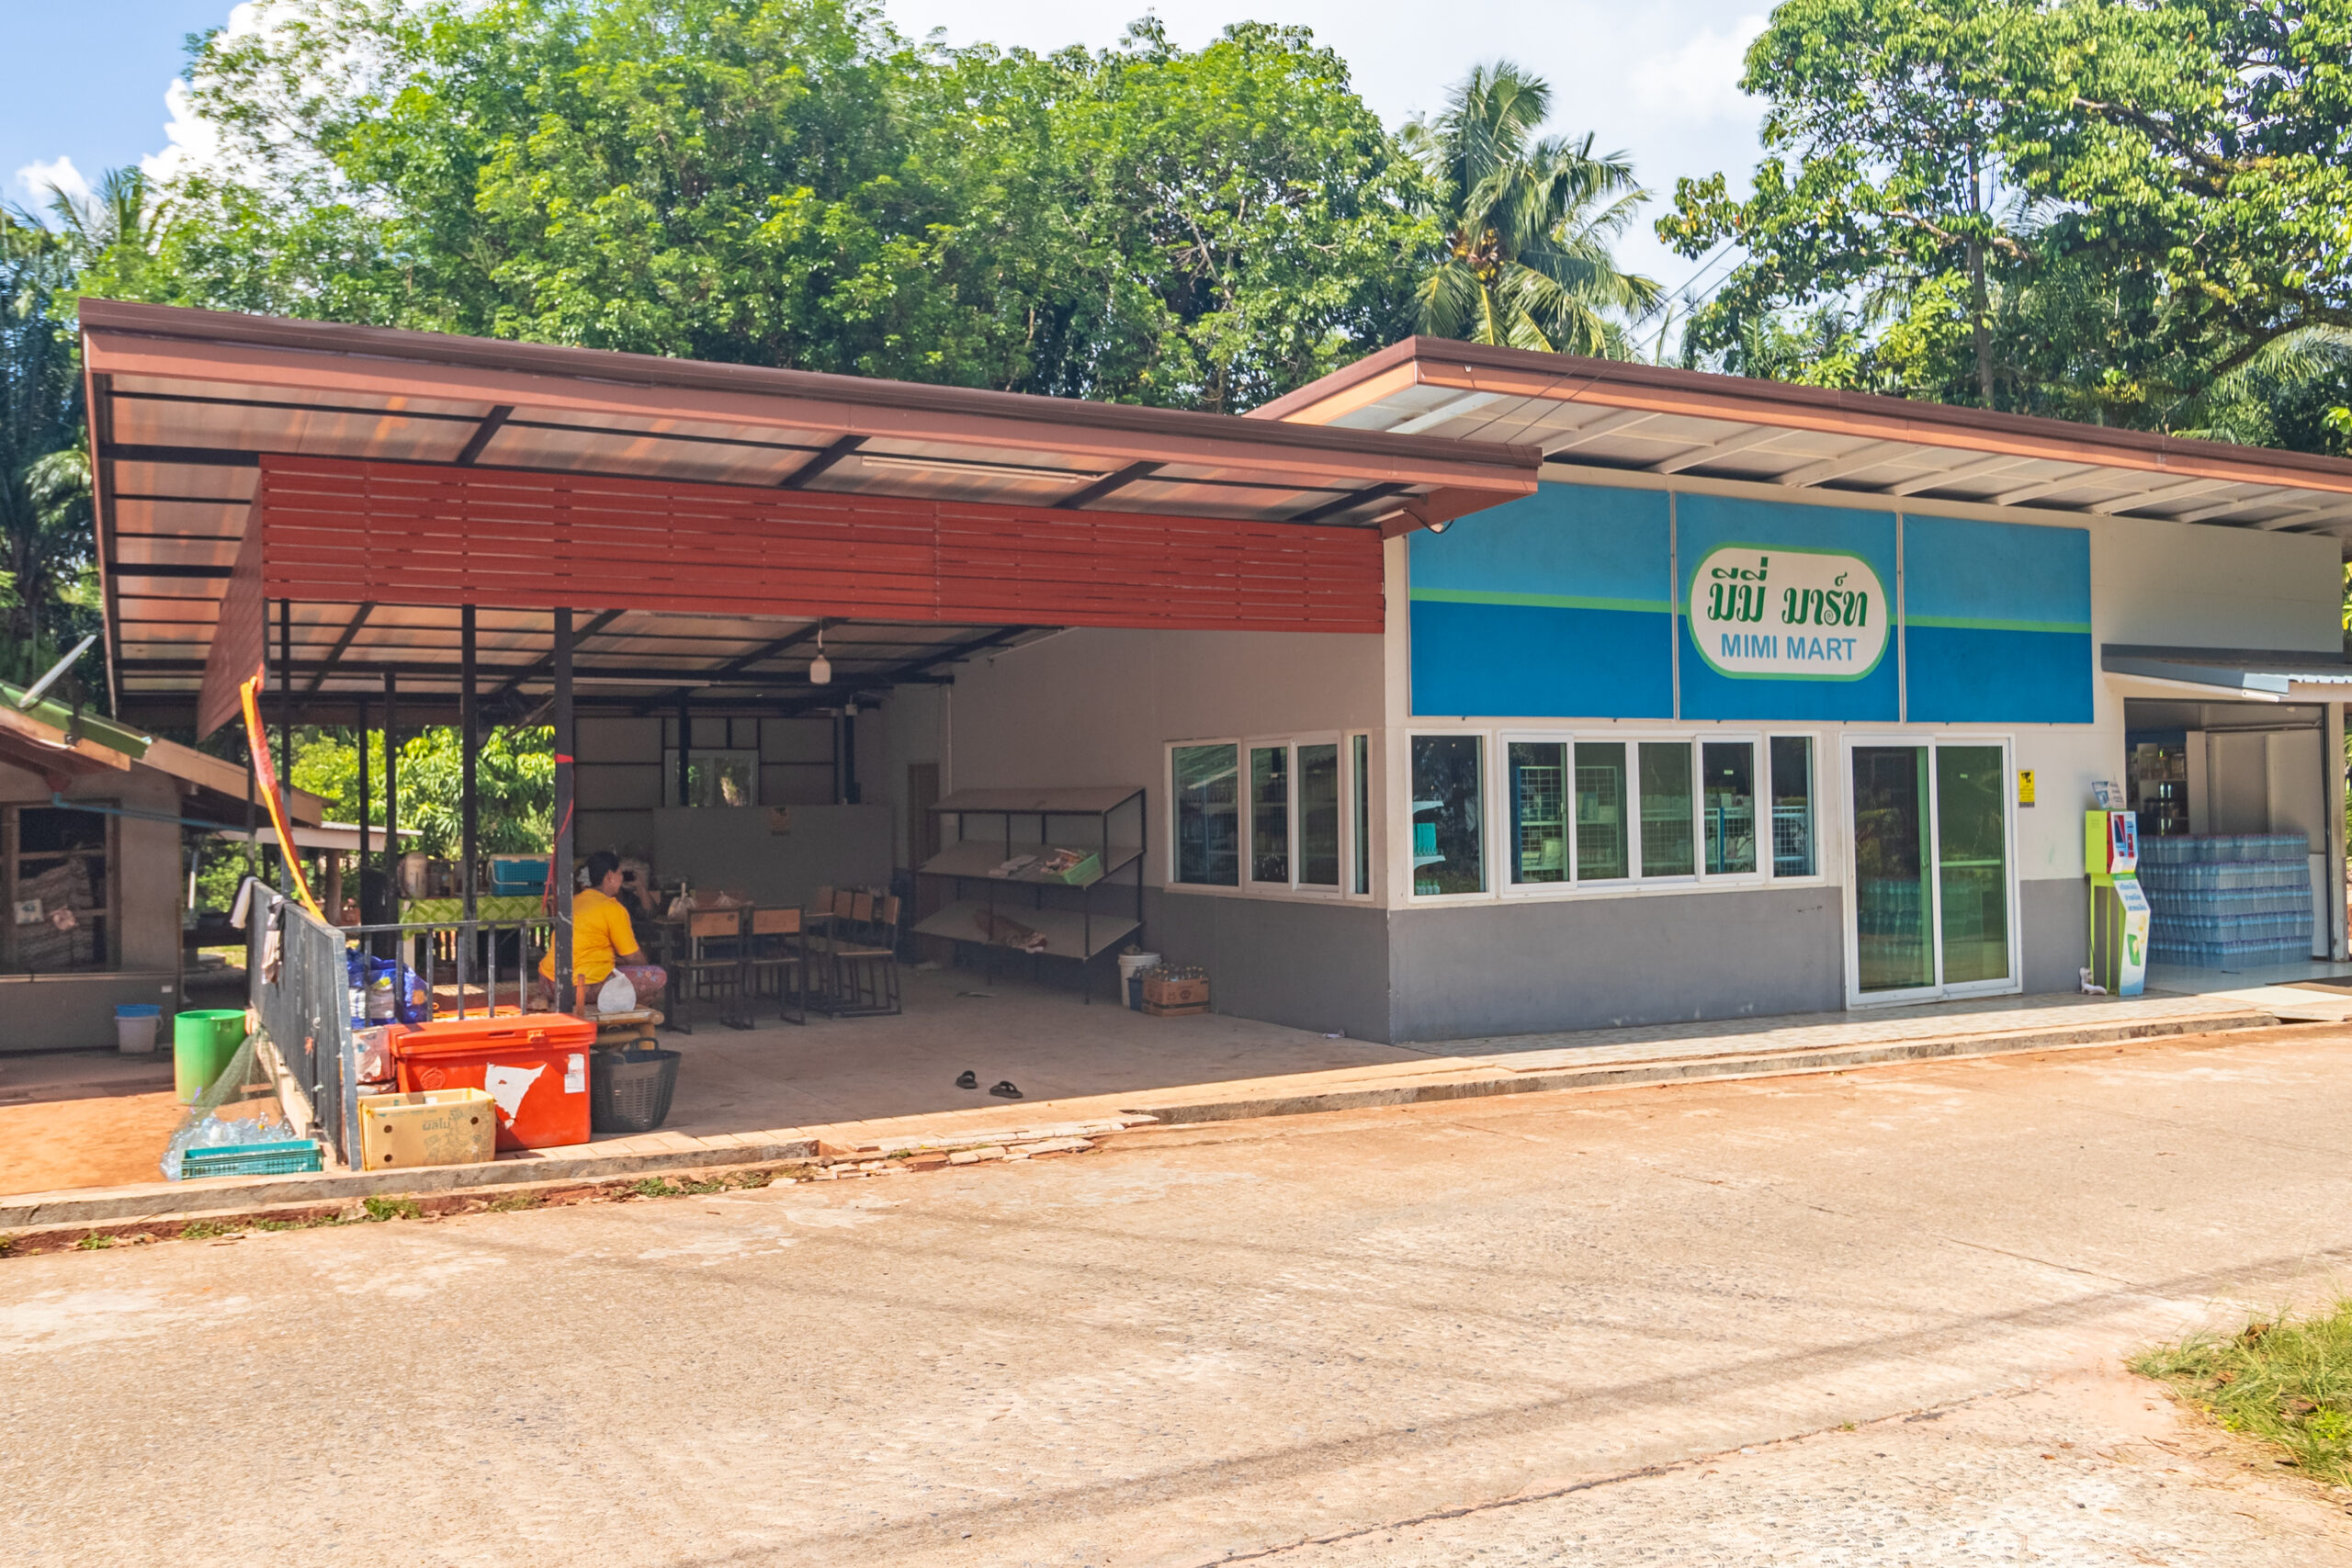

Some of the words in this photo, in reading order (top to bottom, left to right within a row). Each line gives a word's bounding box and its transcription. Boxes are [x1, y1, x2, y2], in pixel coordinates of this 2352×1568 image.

[1707, 556, 1769, 622] มีมี่
[1781, 571, 1868, 626] มาร์ท
[1721, 633, 1778, 659] MIMI
[1786, 637, 1857, 661] MART
